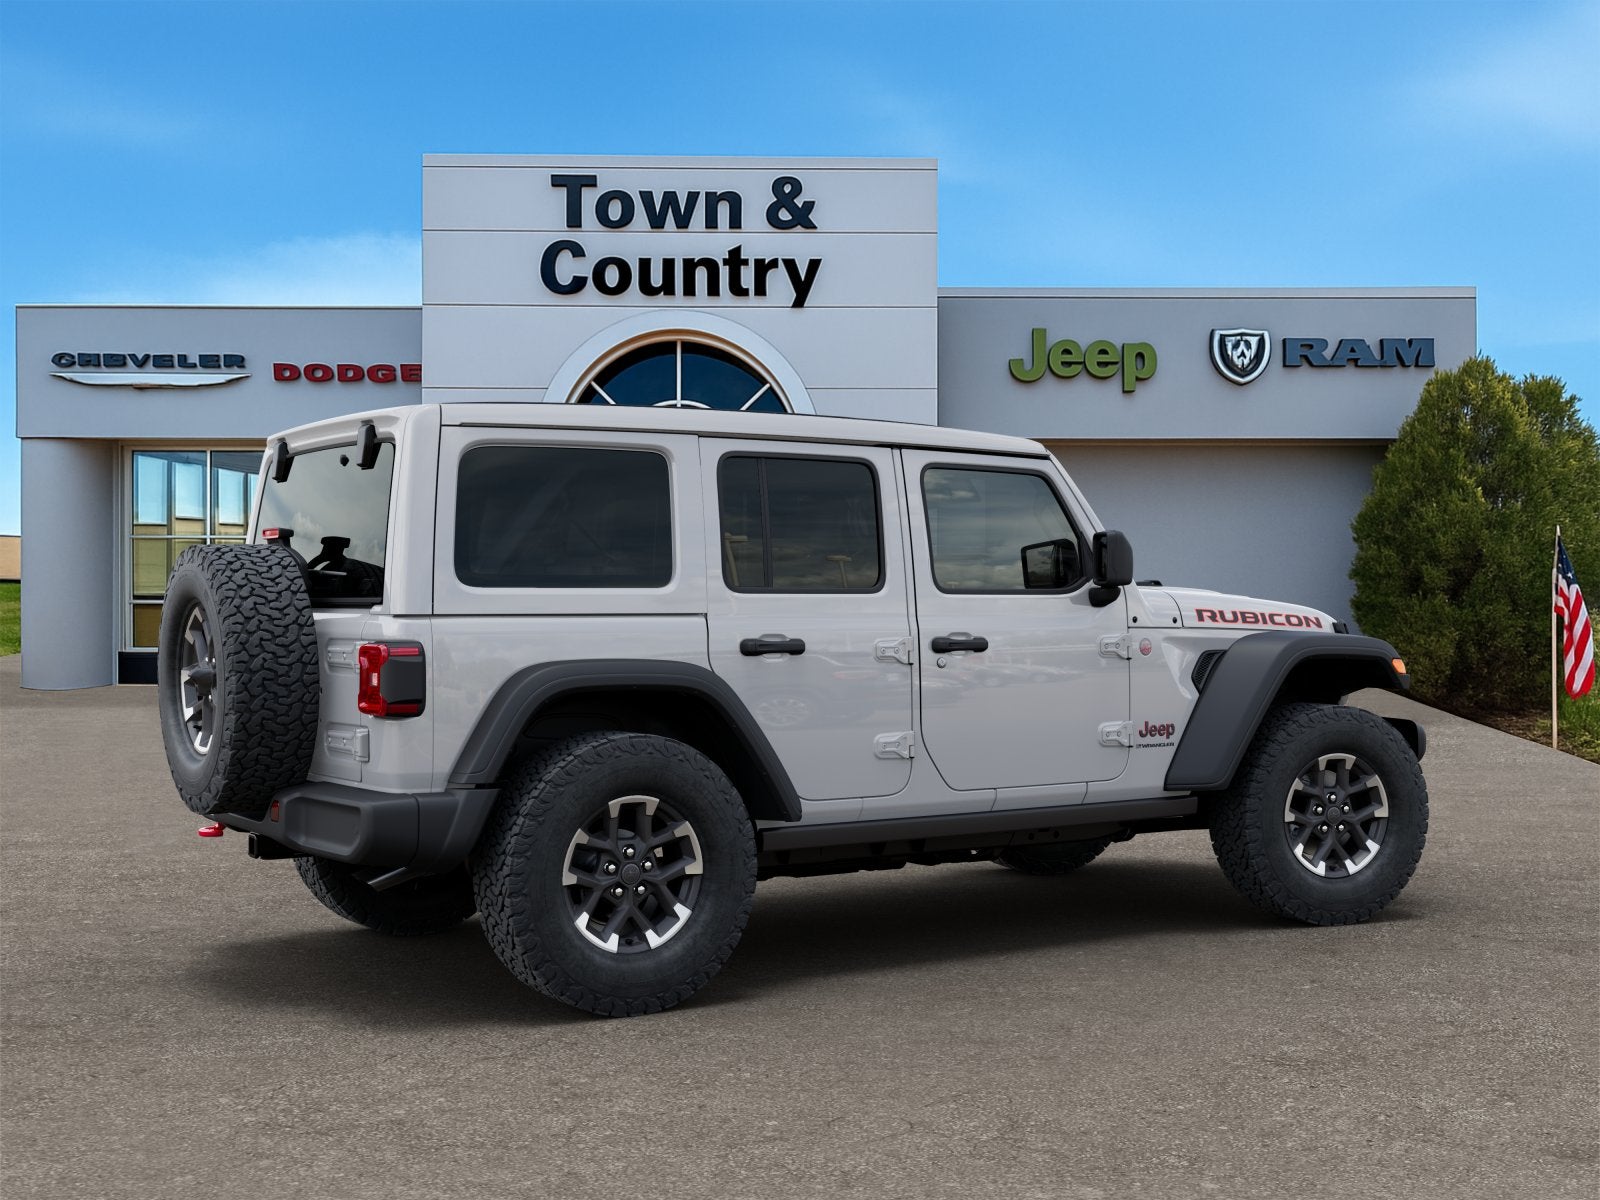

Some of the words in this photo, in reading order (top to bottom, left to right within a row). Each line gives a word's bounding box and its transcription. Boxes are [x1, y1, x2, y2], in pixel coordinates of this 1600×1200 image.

[550, 174, 743, 229] Town
[765, 175, 818, 230] &
[540, 239, 823, 308] Country
[1009, 328, 1158, 393] Jeep
[1282, 337, 1436, 368] RAM
[273, 363, 421, 383] DODGE
[1195, 608, 1323, 628] RUBICON
[1138, 720, 1175, 739] Jeep
